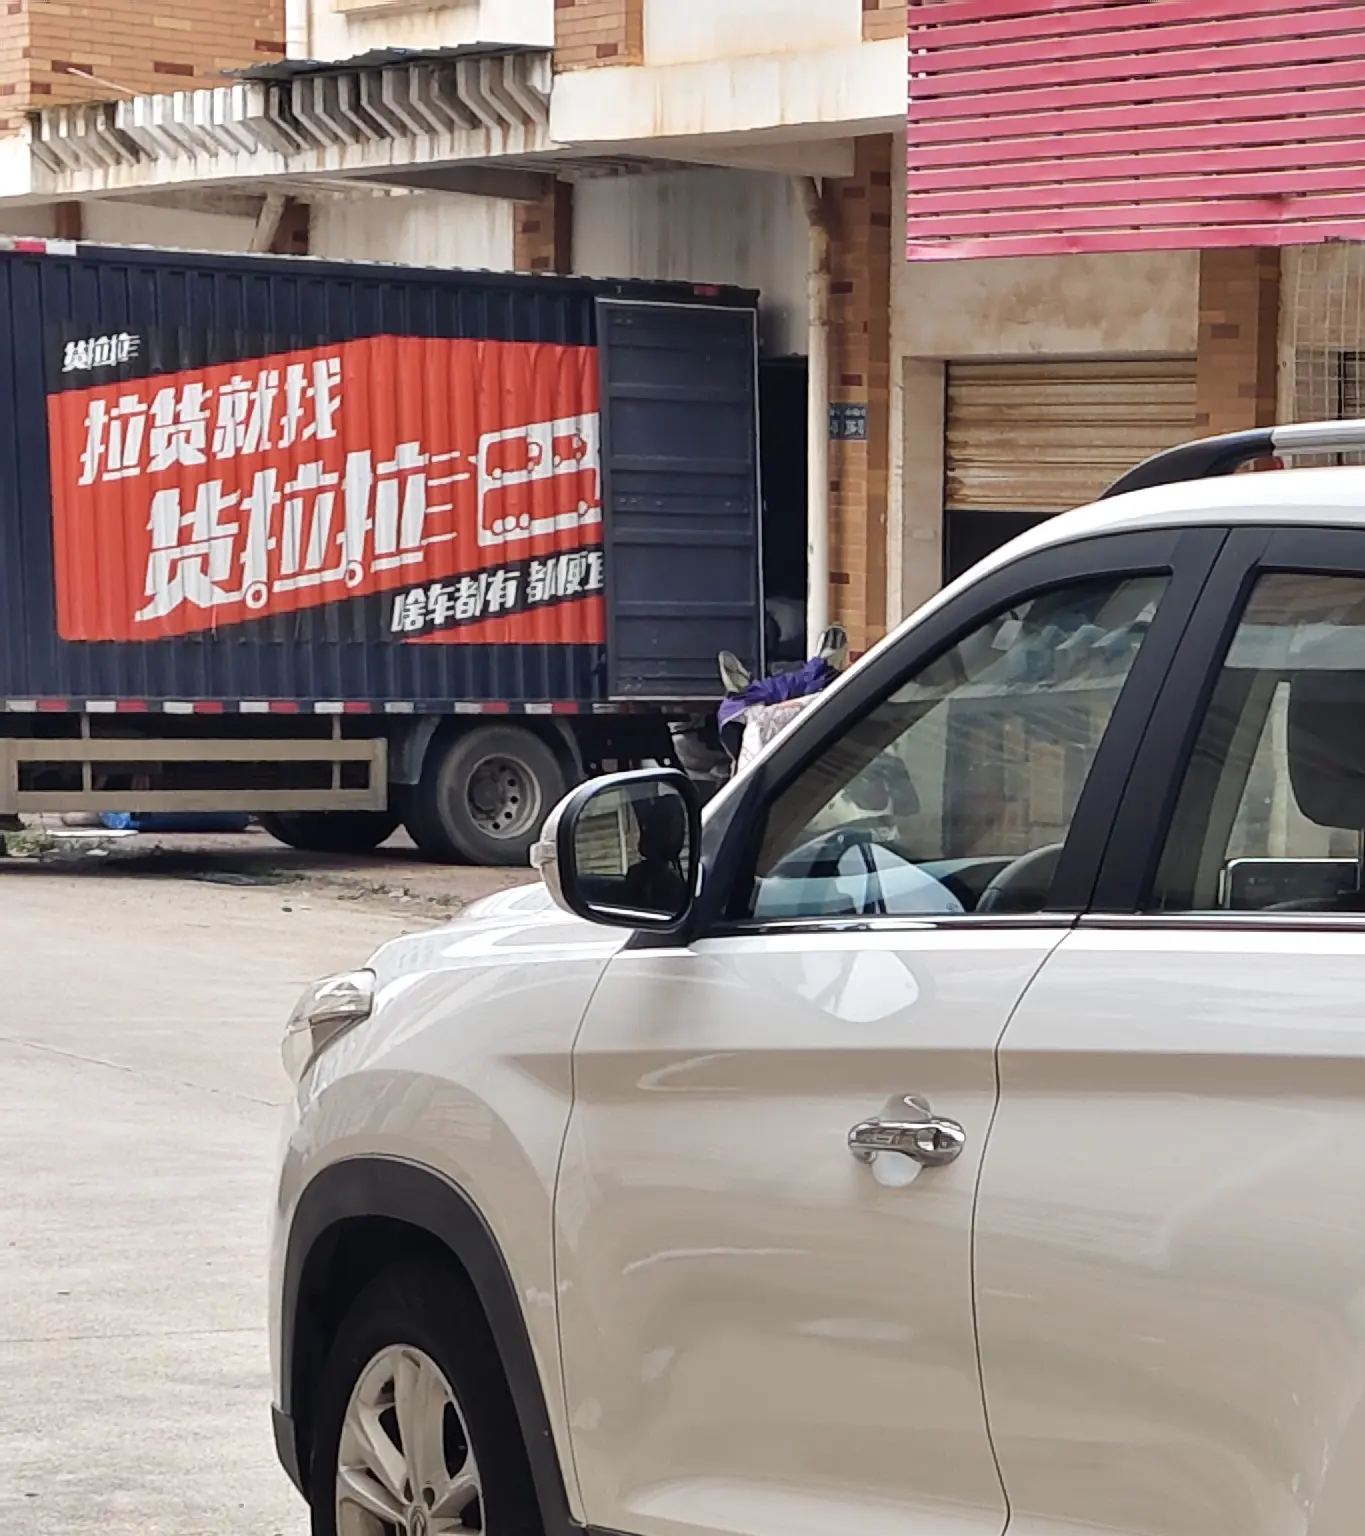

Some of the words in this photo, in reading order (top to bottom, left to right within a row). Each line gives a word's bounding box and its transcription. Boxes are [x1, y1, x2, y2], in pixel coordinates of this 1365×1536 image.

[77, 357, 341, 487] 拉货就找
[134, 440, 428, 622] 货拉拉
[390, 569, 521, 632] 啥车都有
